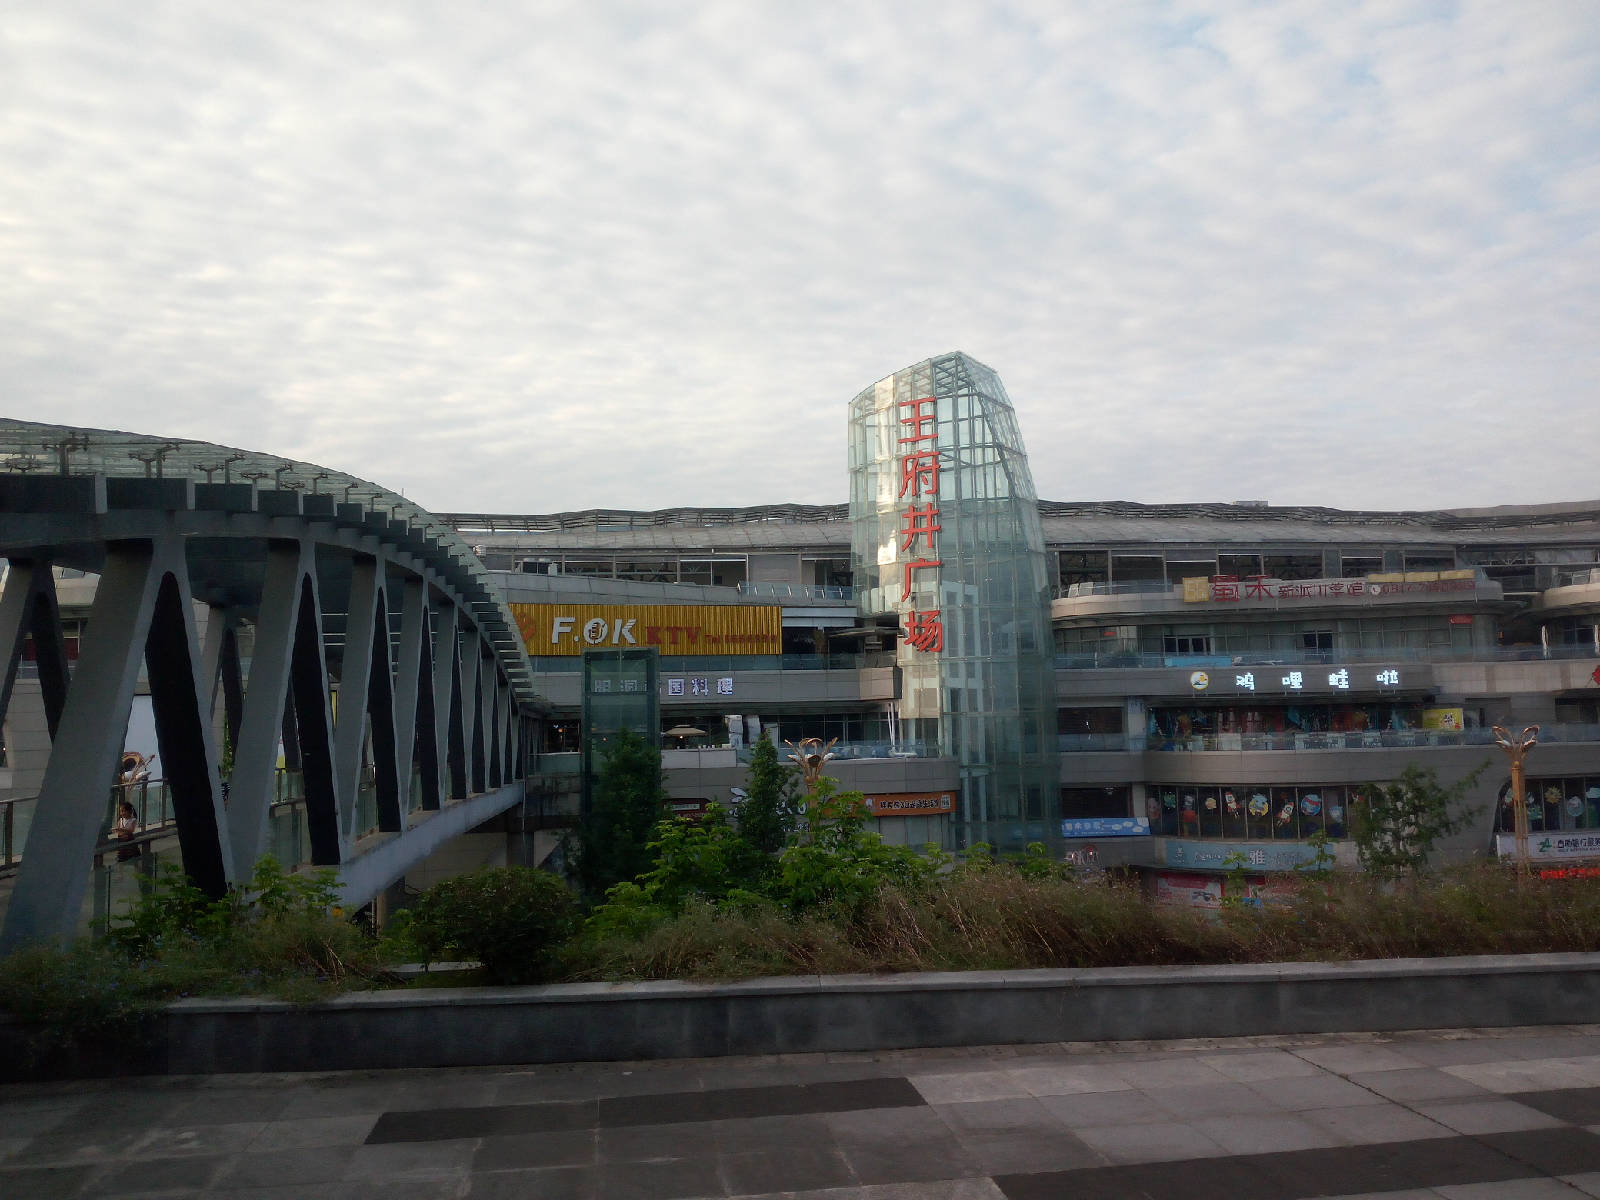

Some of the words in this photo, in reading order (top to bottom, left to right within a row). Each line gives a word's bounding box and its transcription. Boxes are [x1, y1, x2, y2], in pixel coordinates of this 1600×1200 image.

[897, 396, 943, 653] 王府井广场
[551, 616, 637, 645] F.OK
[645, 626, 702, 645] KTV
[594, 677, 734, 696] 明洞国料理
